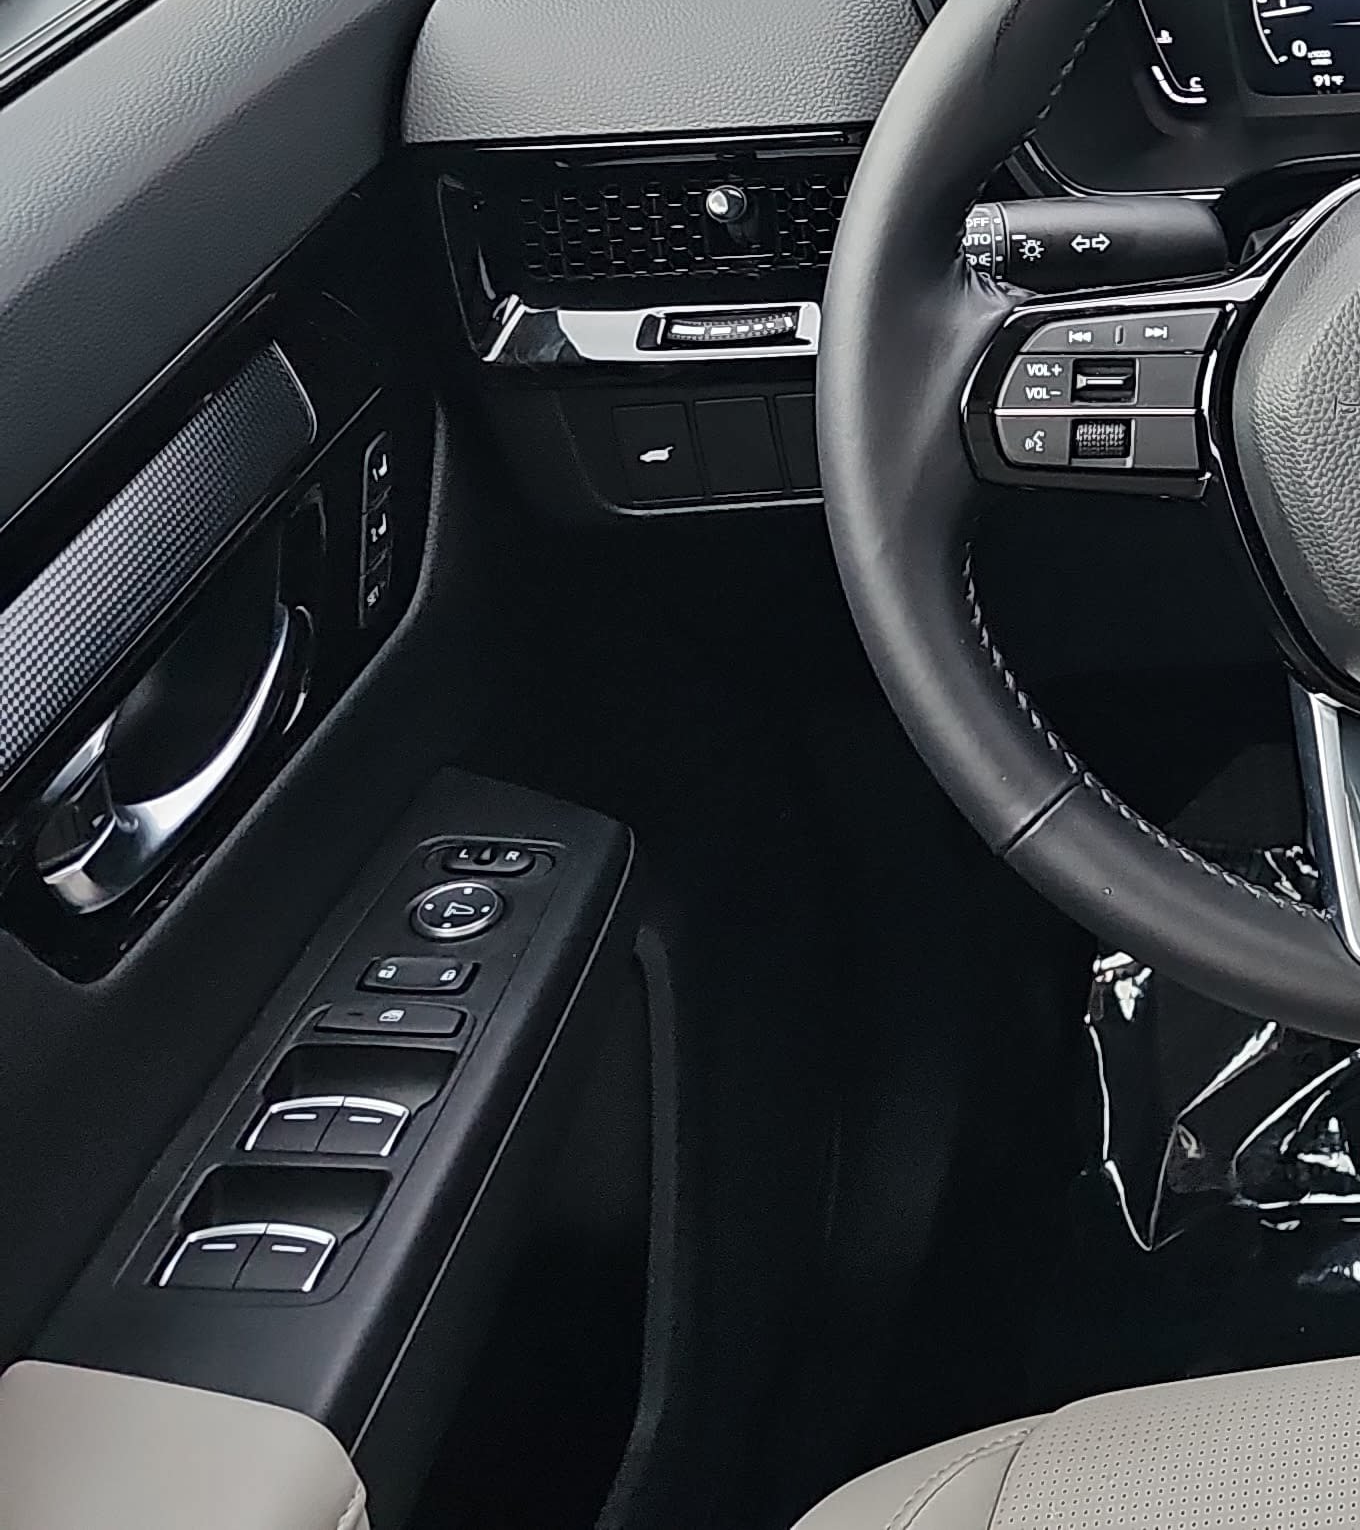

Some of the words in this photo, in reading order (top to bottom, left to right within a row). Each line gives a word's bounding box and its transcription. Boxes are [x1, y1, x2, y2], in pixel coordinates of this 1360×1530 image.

[1291, 39, 1308, 58] 0
[965, 217, 990, 229] OFF
[962, 233, 992, 247] UTO
[1026, 363, 1063, 377] VOL+
[458, 848, 469, 859] L
[504, 850, 521, 861] R
